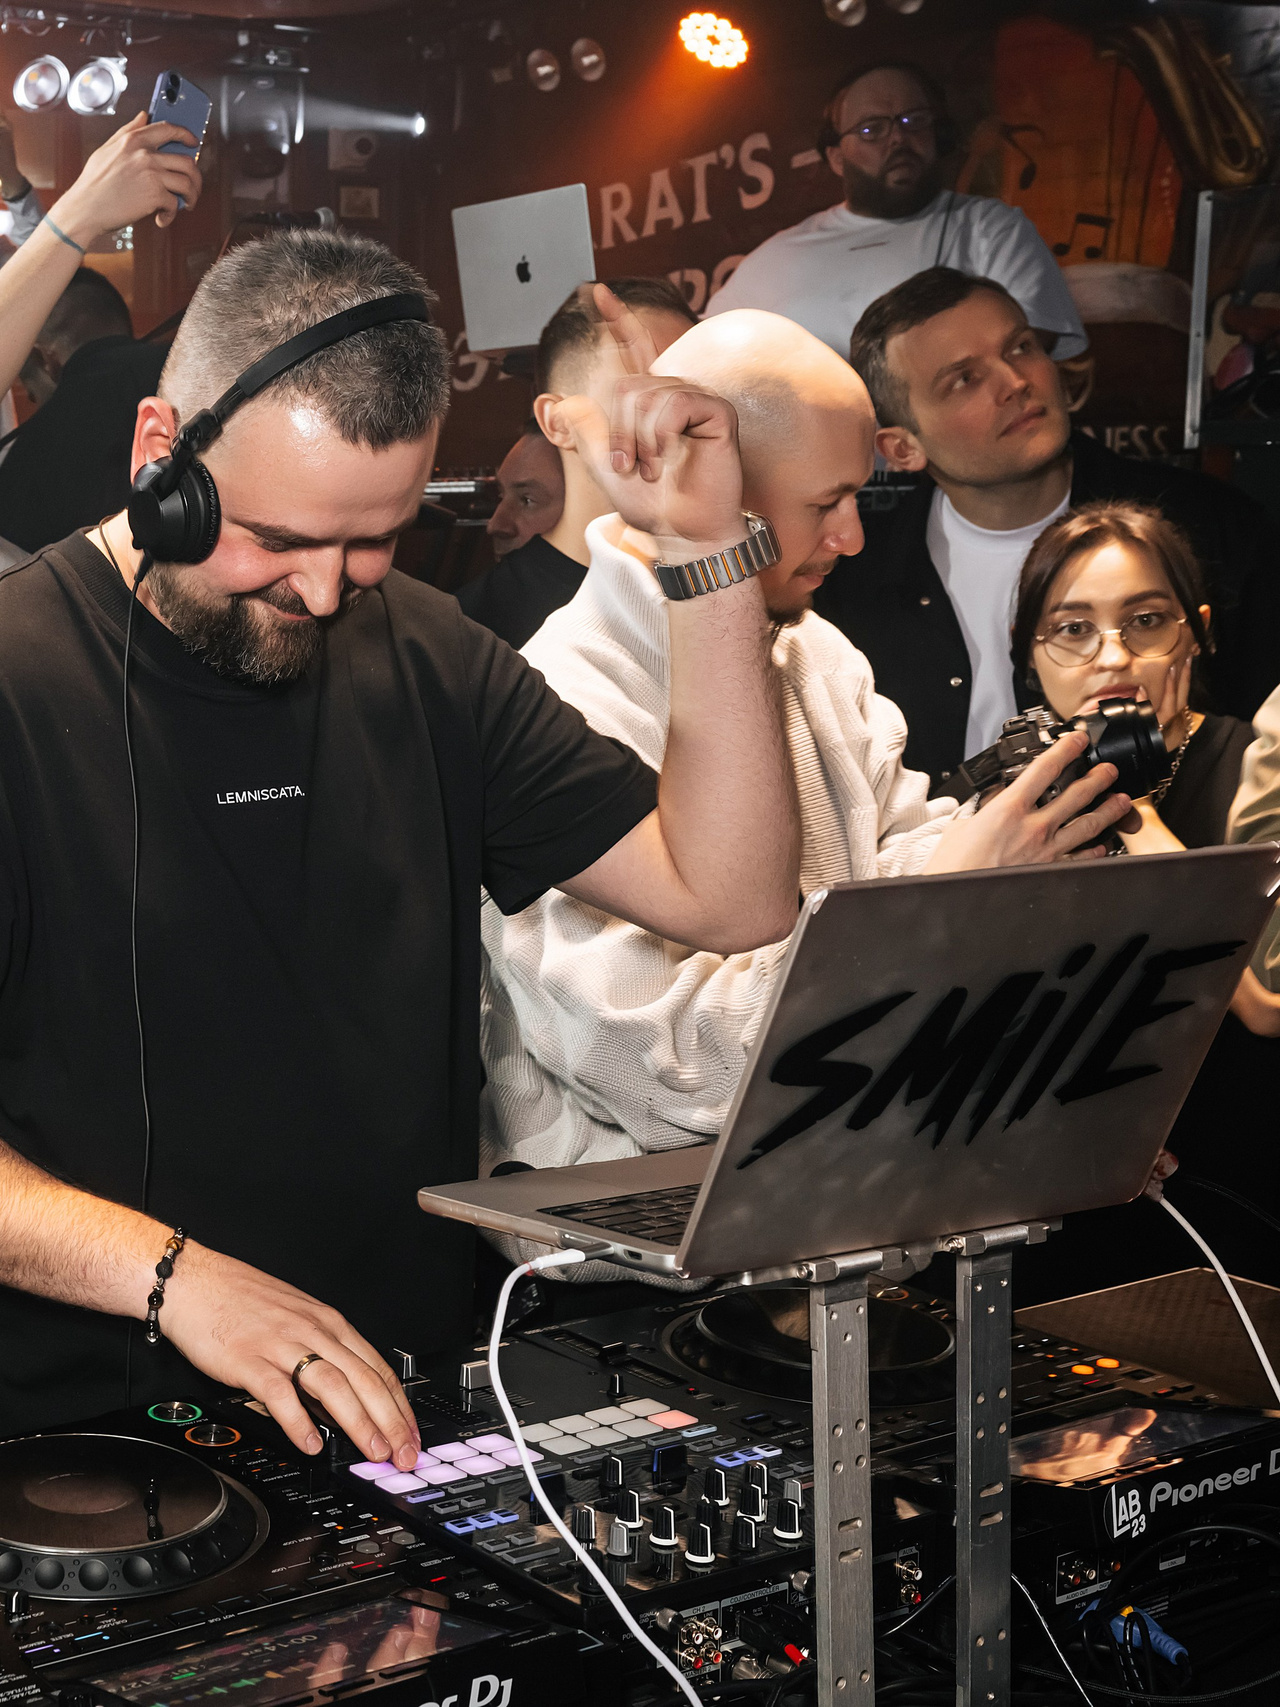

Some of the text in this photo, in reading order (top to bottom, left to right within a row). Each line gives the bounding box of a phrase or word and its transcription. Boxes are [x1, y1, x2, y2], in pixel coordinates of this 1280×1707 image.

[595, 132, 776, 251] RAT'S
[216, 785, 306, 805] LEMNISCATA.
[1149, 1448, 1280, 1513] Pioneer D
[1110, 1483, 1142, 1539] LAB
[1131, 1513, 1147, 1539] 23
[730, 1585, 780, 1604] CDJ/CONTROLLER
[469, 1674, 513, 1707] DJ
